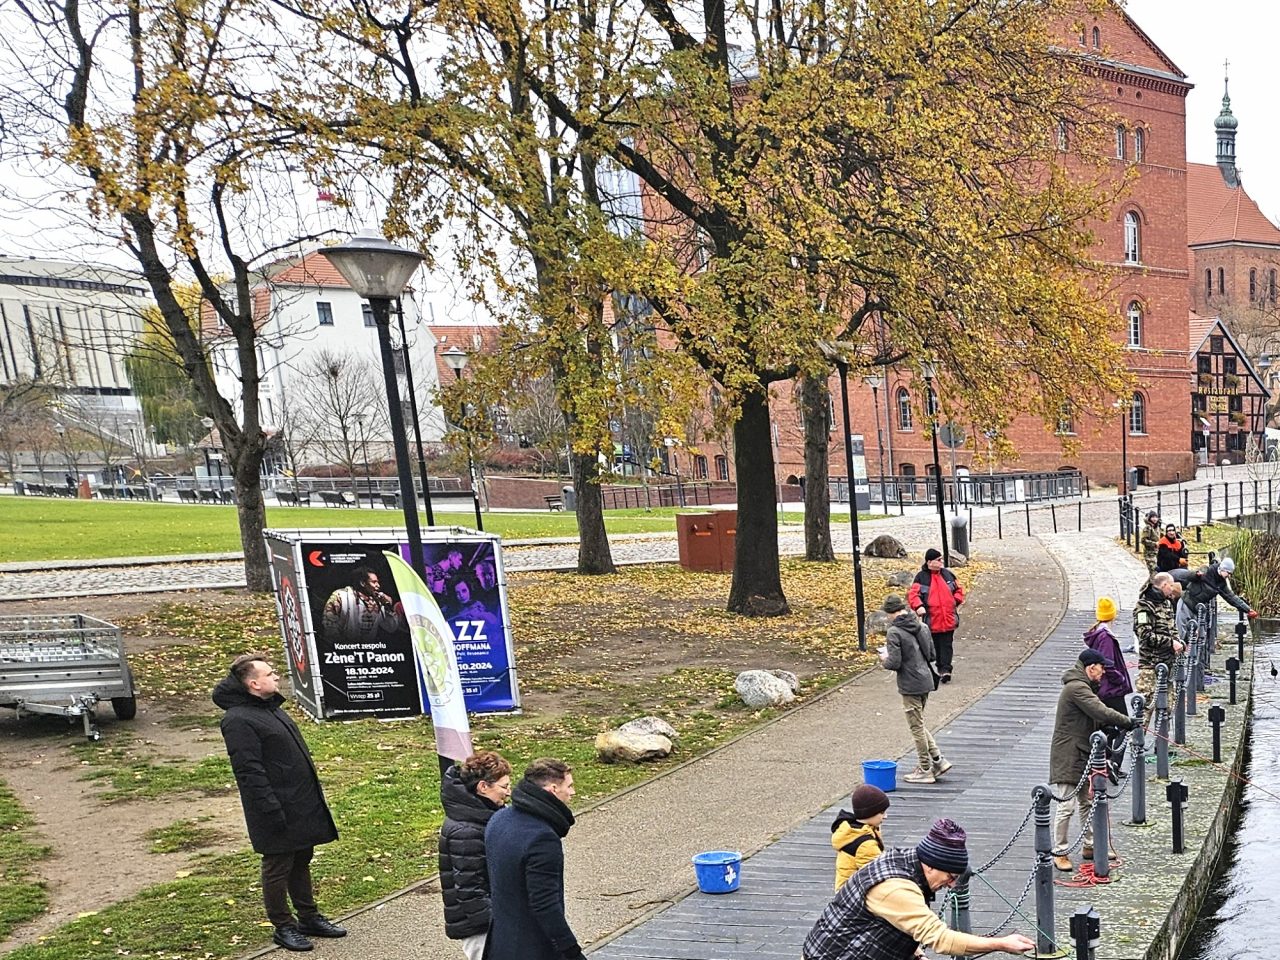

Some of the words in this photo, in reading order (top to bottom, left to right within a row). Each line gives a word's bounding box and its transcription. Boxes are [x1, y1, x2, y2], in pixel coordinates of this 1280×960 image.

[1198, 387, 1238, 395] Restaurant
[334, 642, 361, 650] Koncert
[361, 641, 387, 650] zespołu
[324, 651, 365, 664] Zène'T
[366, 651, 405, 663] Panon
[345, 666, 395, 675] 18.10.2024
